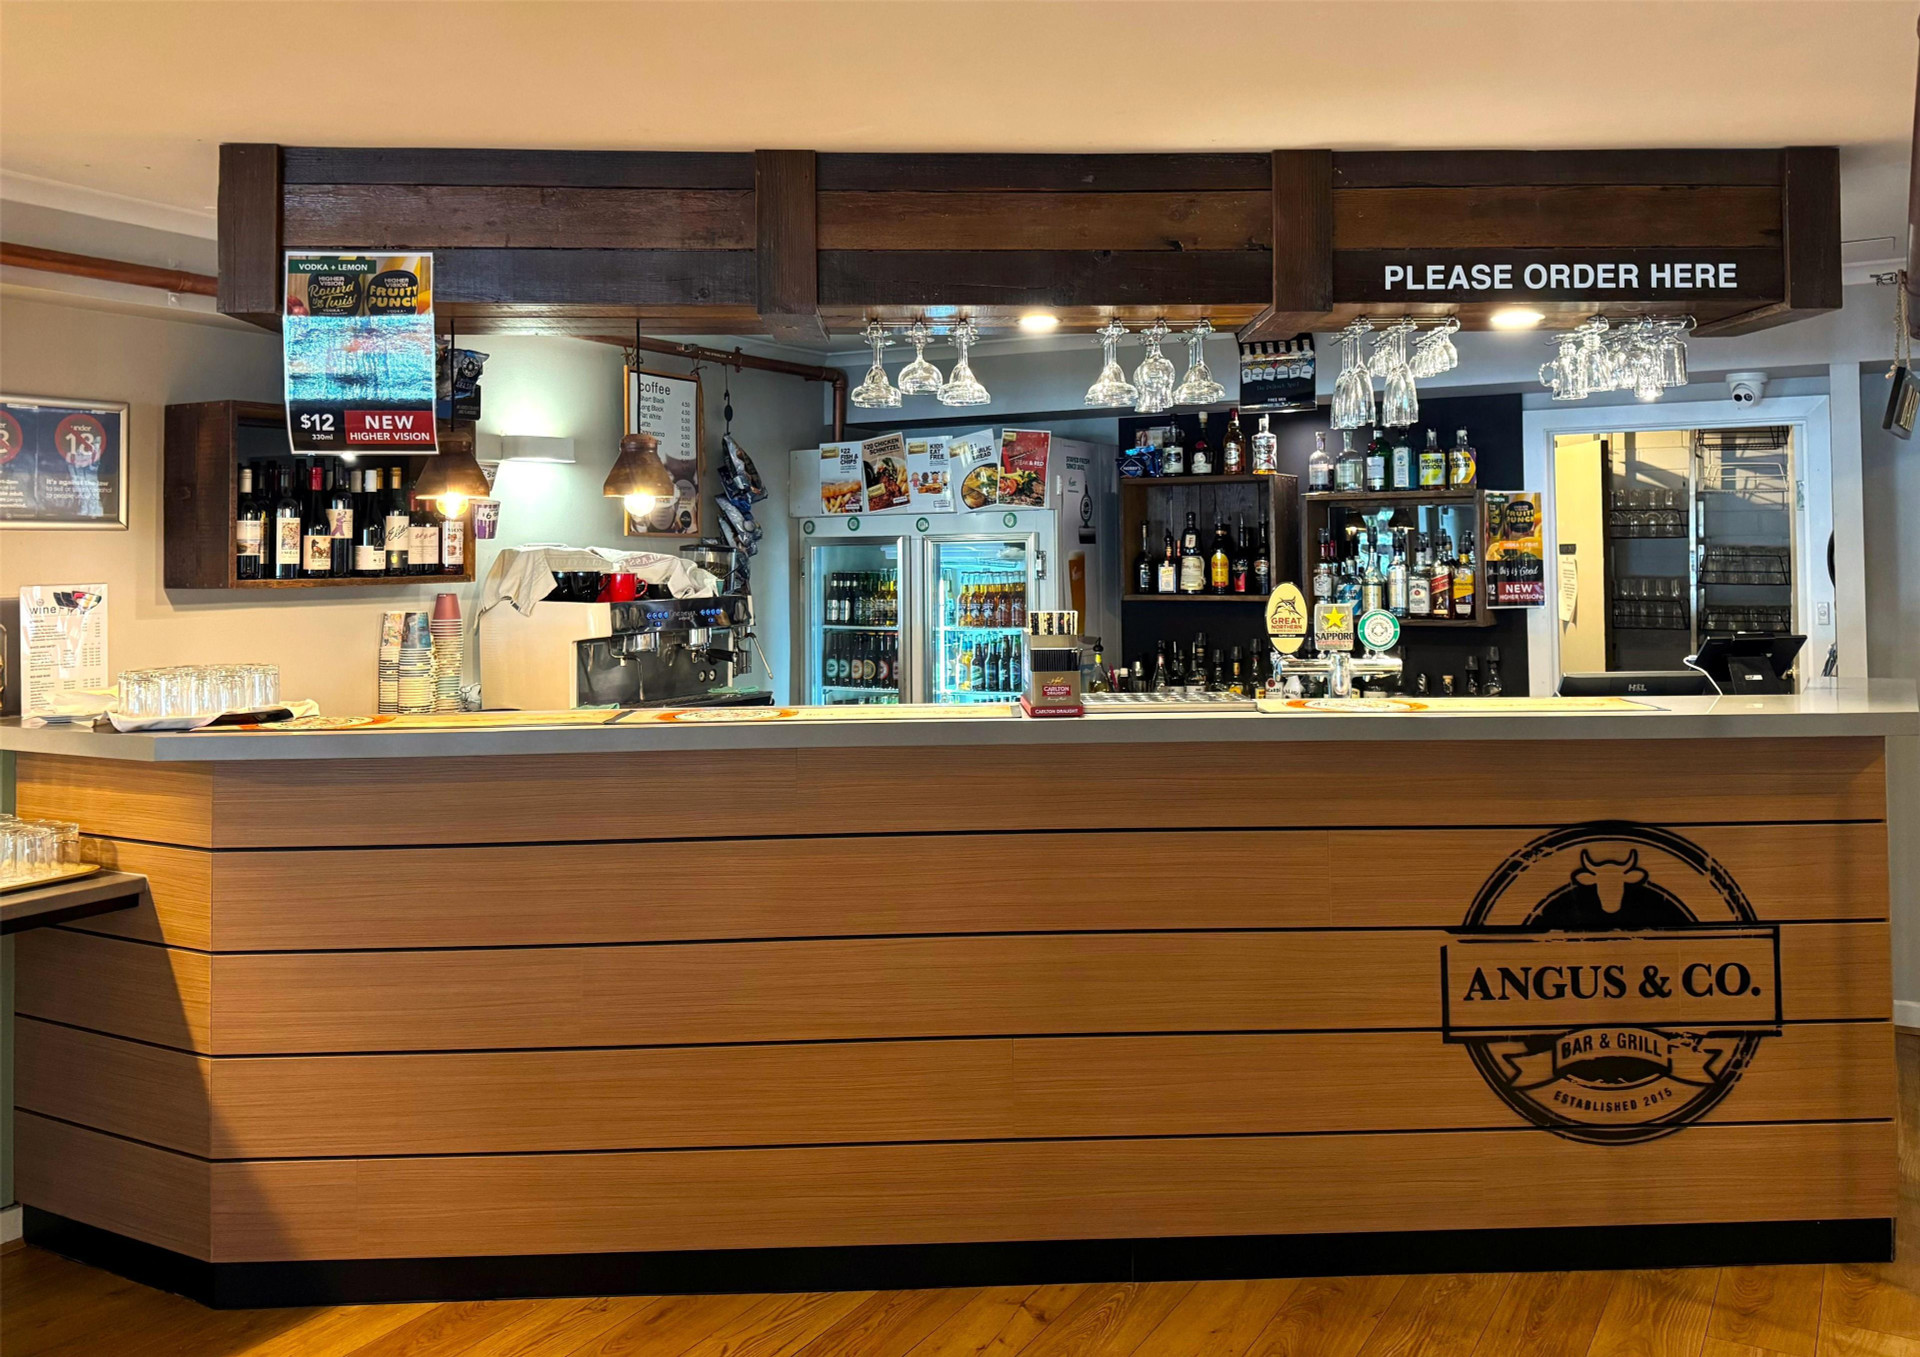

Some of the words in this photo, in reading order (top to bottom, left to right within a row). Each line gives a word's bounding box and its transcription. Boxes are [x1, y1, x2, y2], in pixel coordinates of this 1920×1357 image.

[299, 263, 329, 271] VODKA
[338, 263, 368, 271] LEMON
[1384, 263, 1514, 290] PLEASE
[1523, 263, 1639, 289] ORDER
[1650, 263, 1738, 289] HERE
[308, 281, 355, 297] Round
[369, 284, 418, 297] FRUITY
[640, 381, 671, 396] coffee
[300, 413, 335, 432] $12
[364, 415, 414, 430] NEW
[349, 432, 391, 441] HIGHER
[392, 432, 430, 441] VISION
[971, 445, 992, 455] RLIC
[1505, 584, 1533, 593] NEW
[30, 606, 57, 615] wine
[1271, 617, 1302, 625] GREAT
[1315, 632, 1354, 641] SAPPORO
[1463, 965, 1628, 1001] ANGUS
[1638, 965, 1672, 999] &
[1681, 962, 1762, 998] CO.
[1561, 1033, 1594, 1060] BAR
[1599, 1032, 1611, 1049] &
[1616, 1032, 1662, 1058] GRILL
[1553, 1089, 1638, 1113] ESTABLISHED
[1643, 1087, 1674, 1108] 2015
